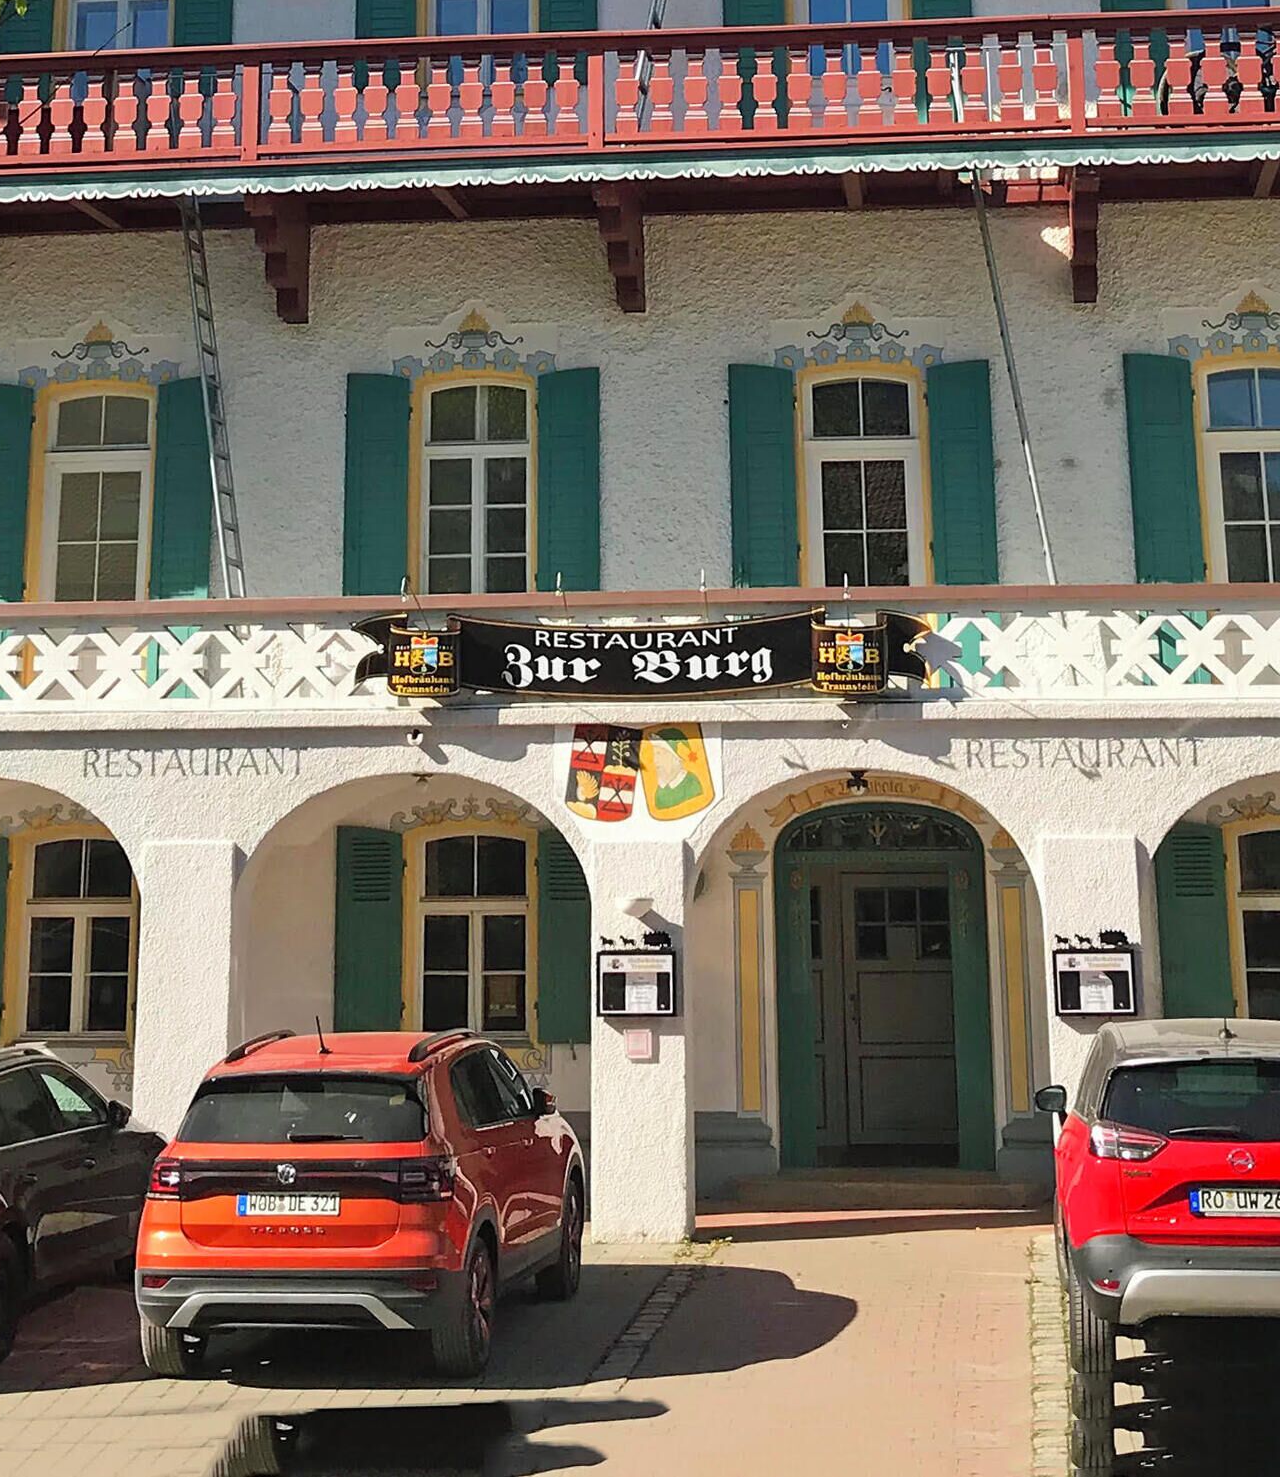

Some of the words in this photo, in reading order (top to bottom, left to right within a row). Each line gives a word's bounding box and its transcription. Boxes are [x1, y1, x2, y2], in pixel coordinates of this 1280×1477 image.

[535, 626, 738, 650] RESTAURANT
[394, 651, 410, 666] H
[438, 652, 454, 666] B
[818, 648, 836, 663] H
[864, 648, 880, 663] B
[501, 644, 602, 688] Zur
[632, 647, 774, 684] Burg
[395, 684, 450, 693] Traunstein
[966, 737, 1203, 769] RESTAURANT
[83, 747, 309, 780] RESTAURANT
[249, 1192, 277, 1212] WOB
[288, 1193, 307, 1212] DE
[311, 1193, 337, 1212] 321
[1201, 1191, 1224, 1209] RO
[1236, 1191, 1259, 1209] UW
